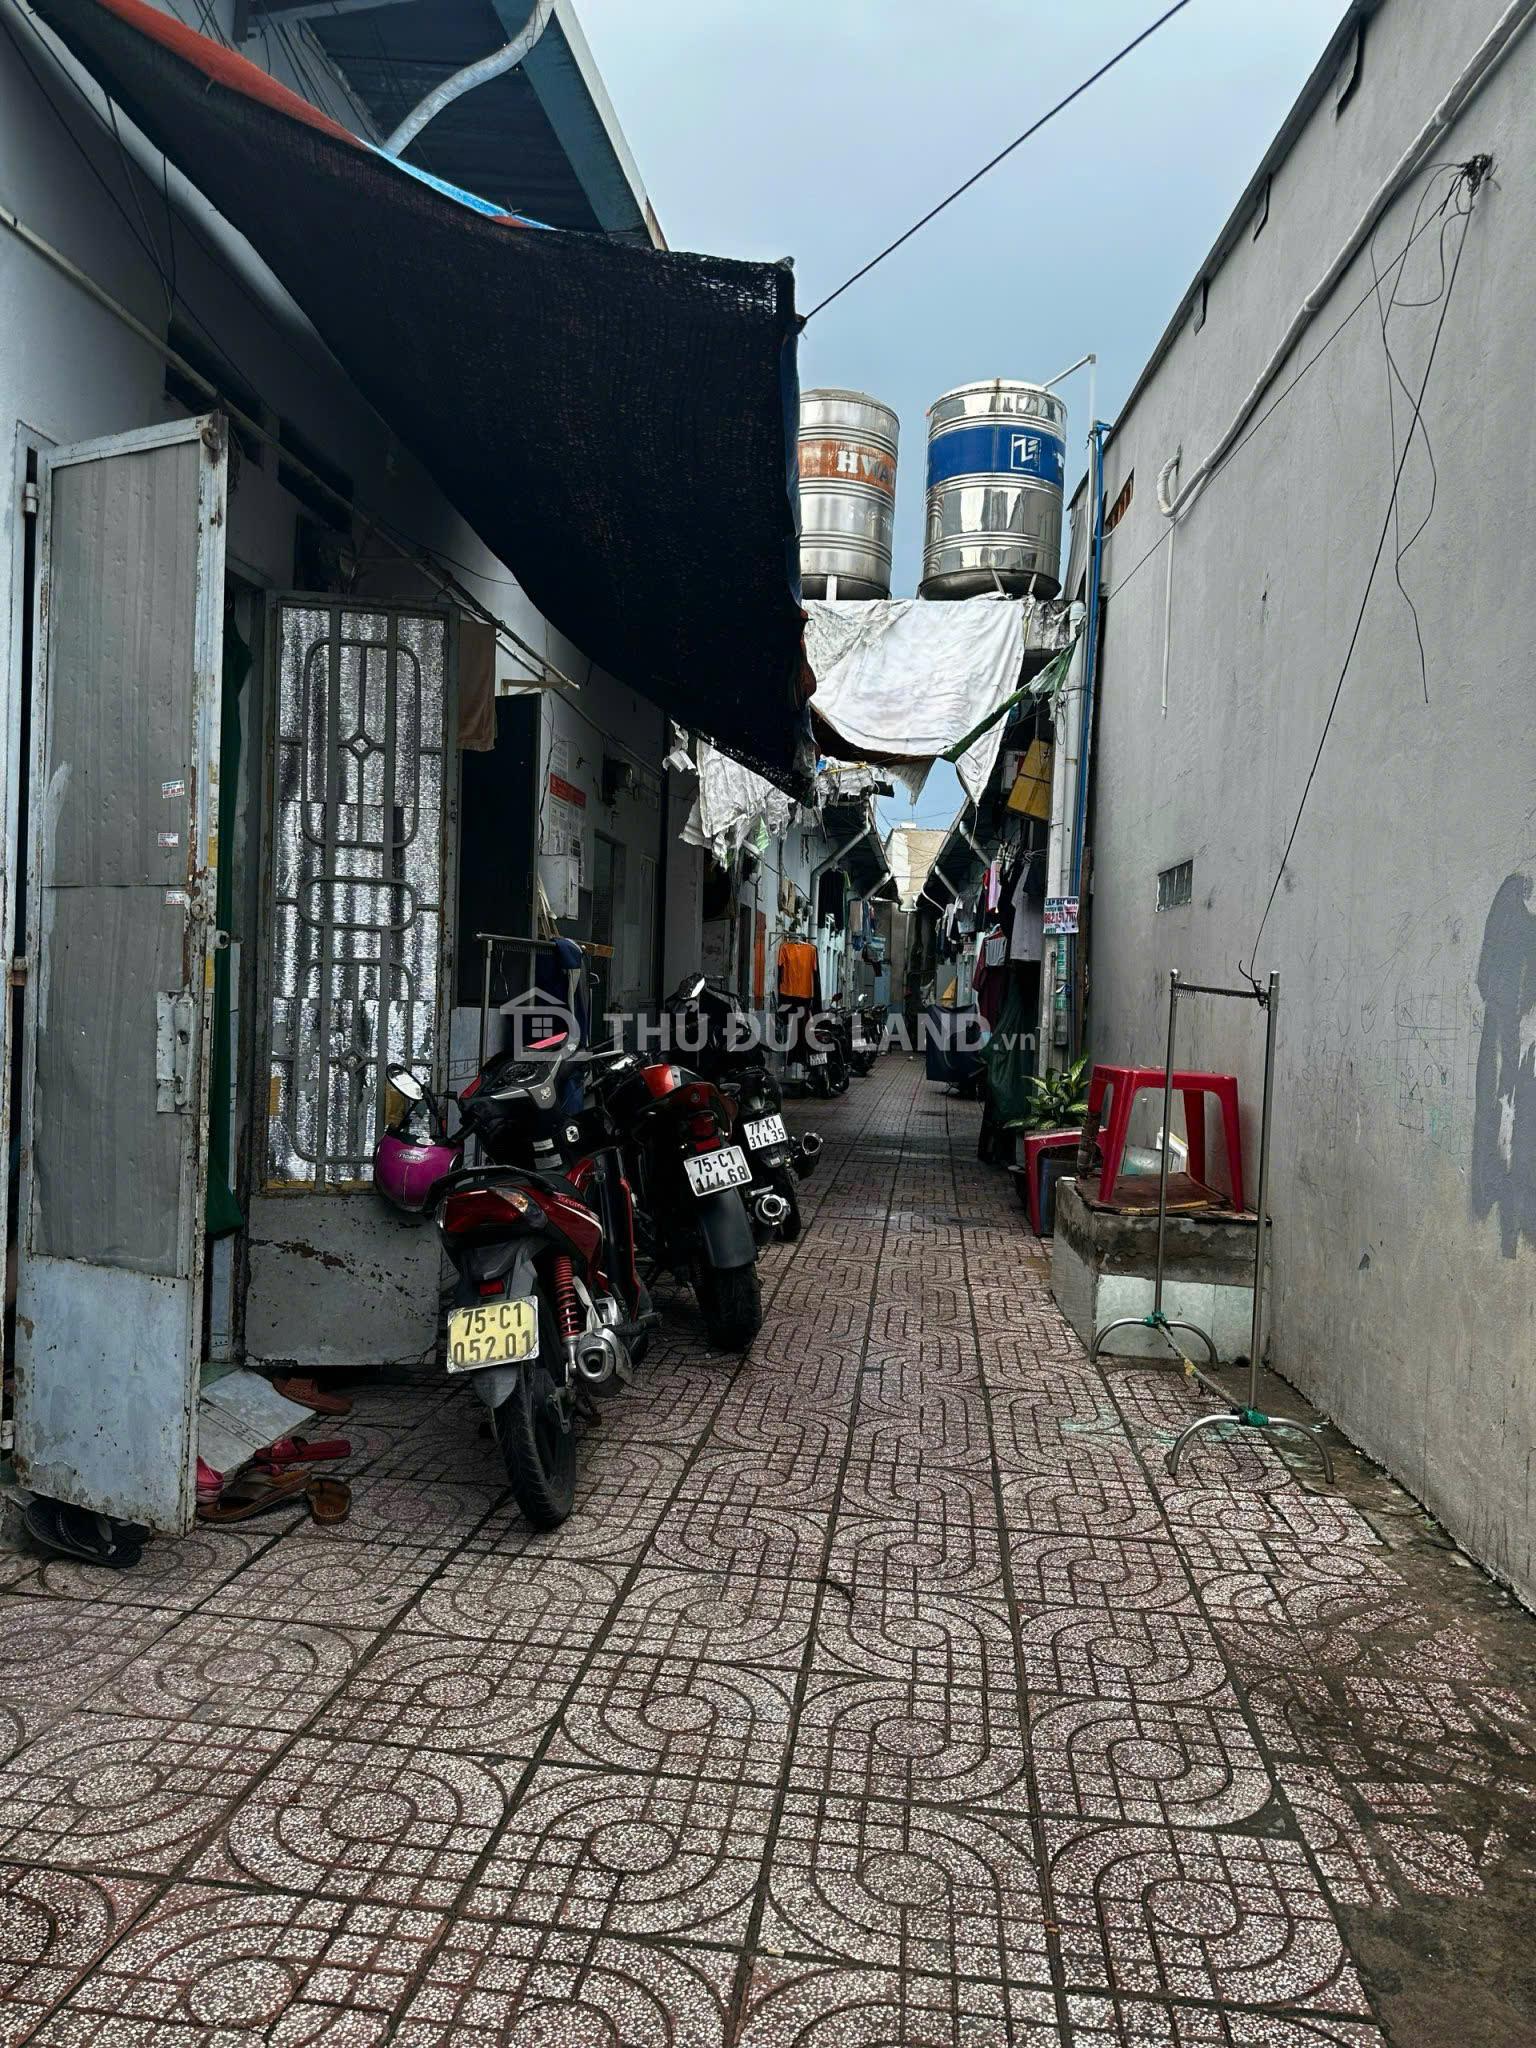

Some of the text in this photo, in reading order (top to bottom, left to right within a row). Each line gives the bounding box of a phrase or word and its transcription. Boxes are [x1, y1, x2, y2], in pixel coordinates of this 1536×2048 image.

[748, 1117, 777, 1136] 77-K1
[748, 1127, 785, 1149] 314.35
[694, 1150, 736, 1175] 75-C1
[695, 1165, 748, 1193] 144.68
[462, 1302, 522, 1337] 75-C1
[453, 1329, 531, 1364] 052.01
